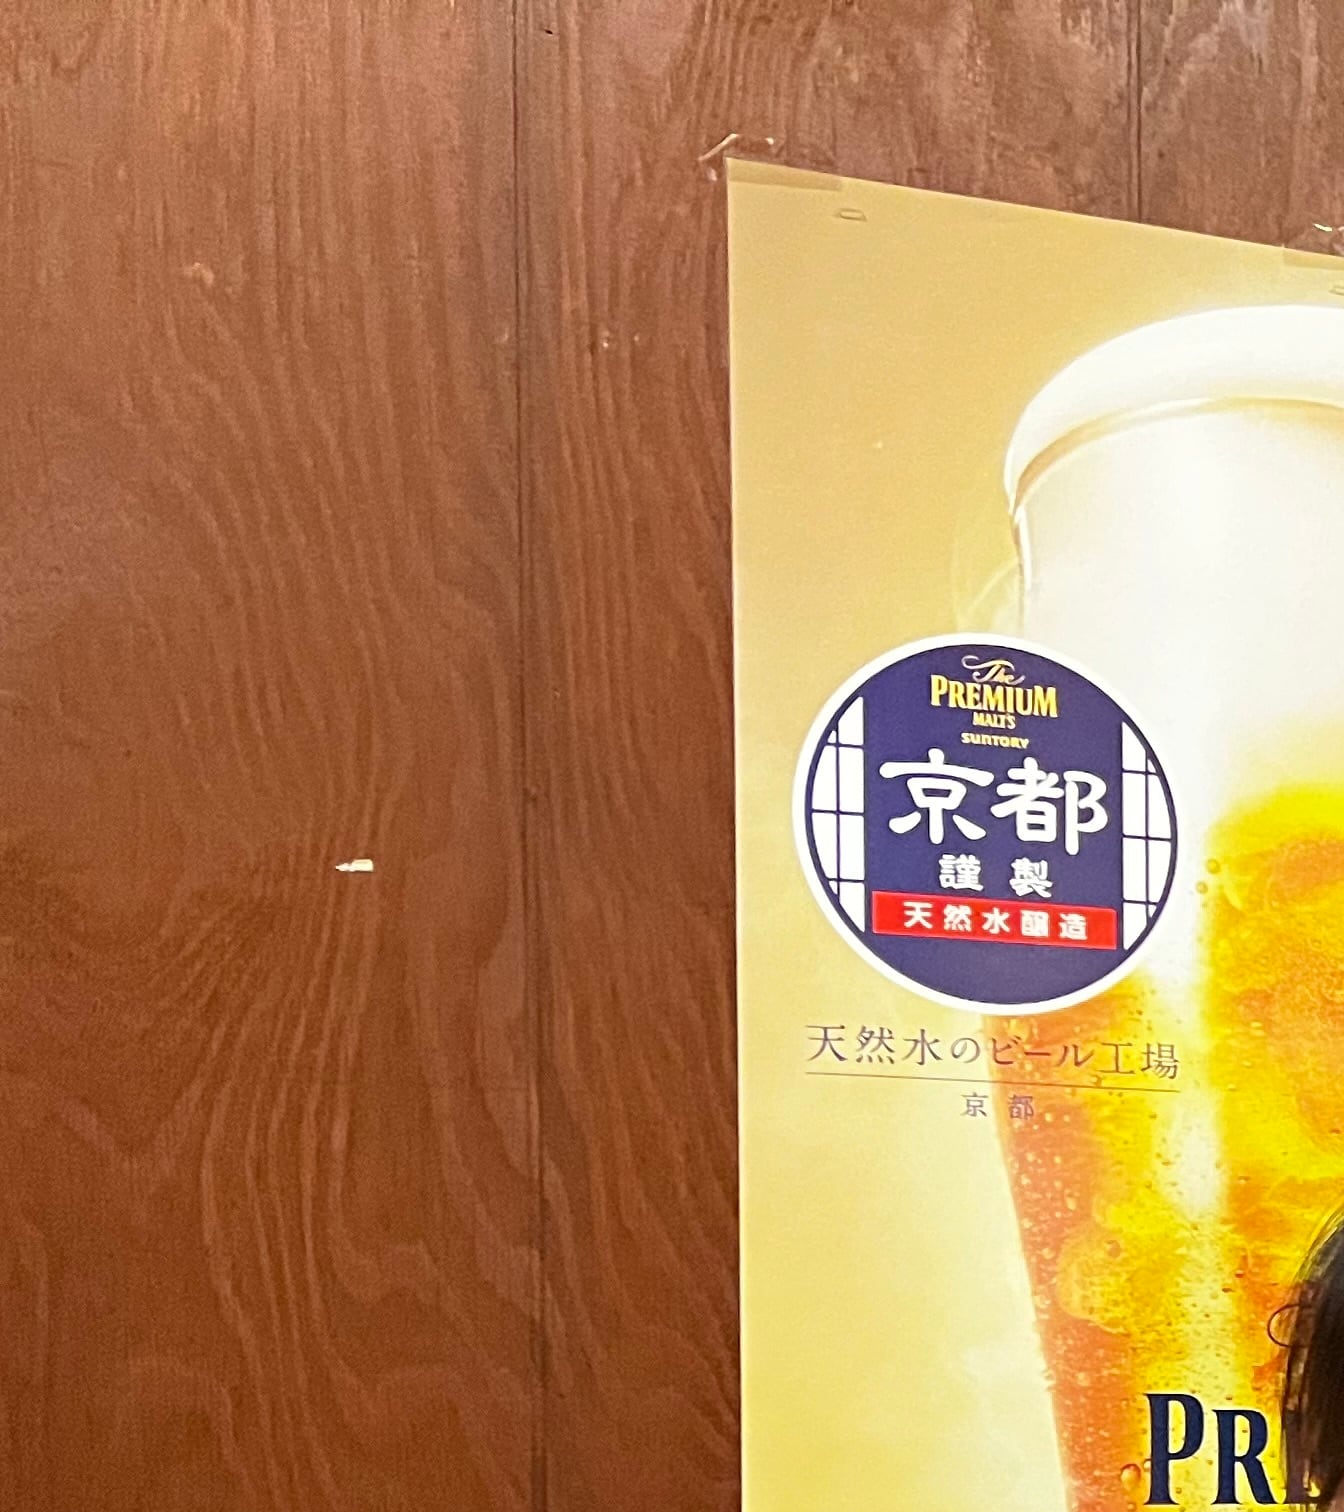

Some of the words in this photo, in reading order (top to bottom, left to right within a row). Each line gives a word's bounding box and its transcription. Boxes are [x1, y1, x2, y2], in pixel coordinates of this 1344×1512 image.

[961, 655, 1026, 685] The
[930, 674, 1058, 718] PREMIUM
[961, 732, 1029, 749] SUNTORY
[879, 748, 1108, 855] 京都
[938, 853, 1054, 899] 謹製
[806, 1024, 1179, 1080] 天然水のビール工場
[961, 1092, 1036, 1120] 京都
